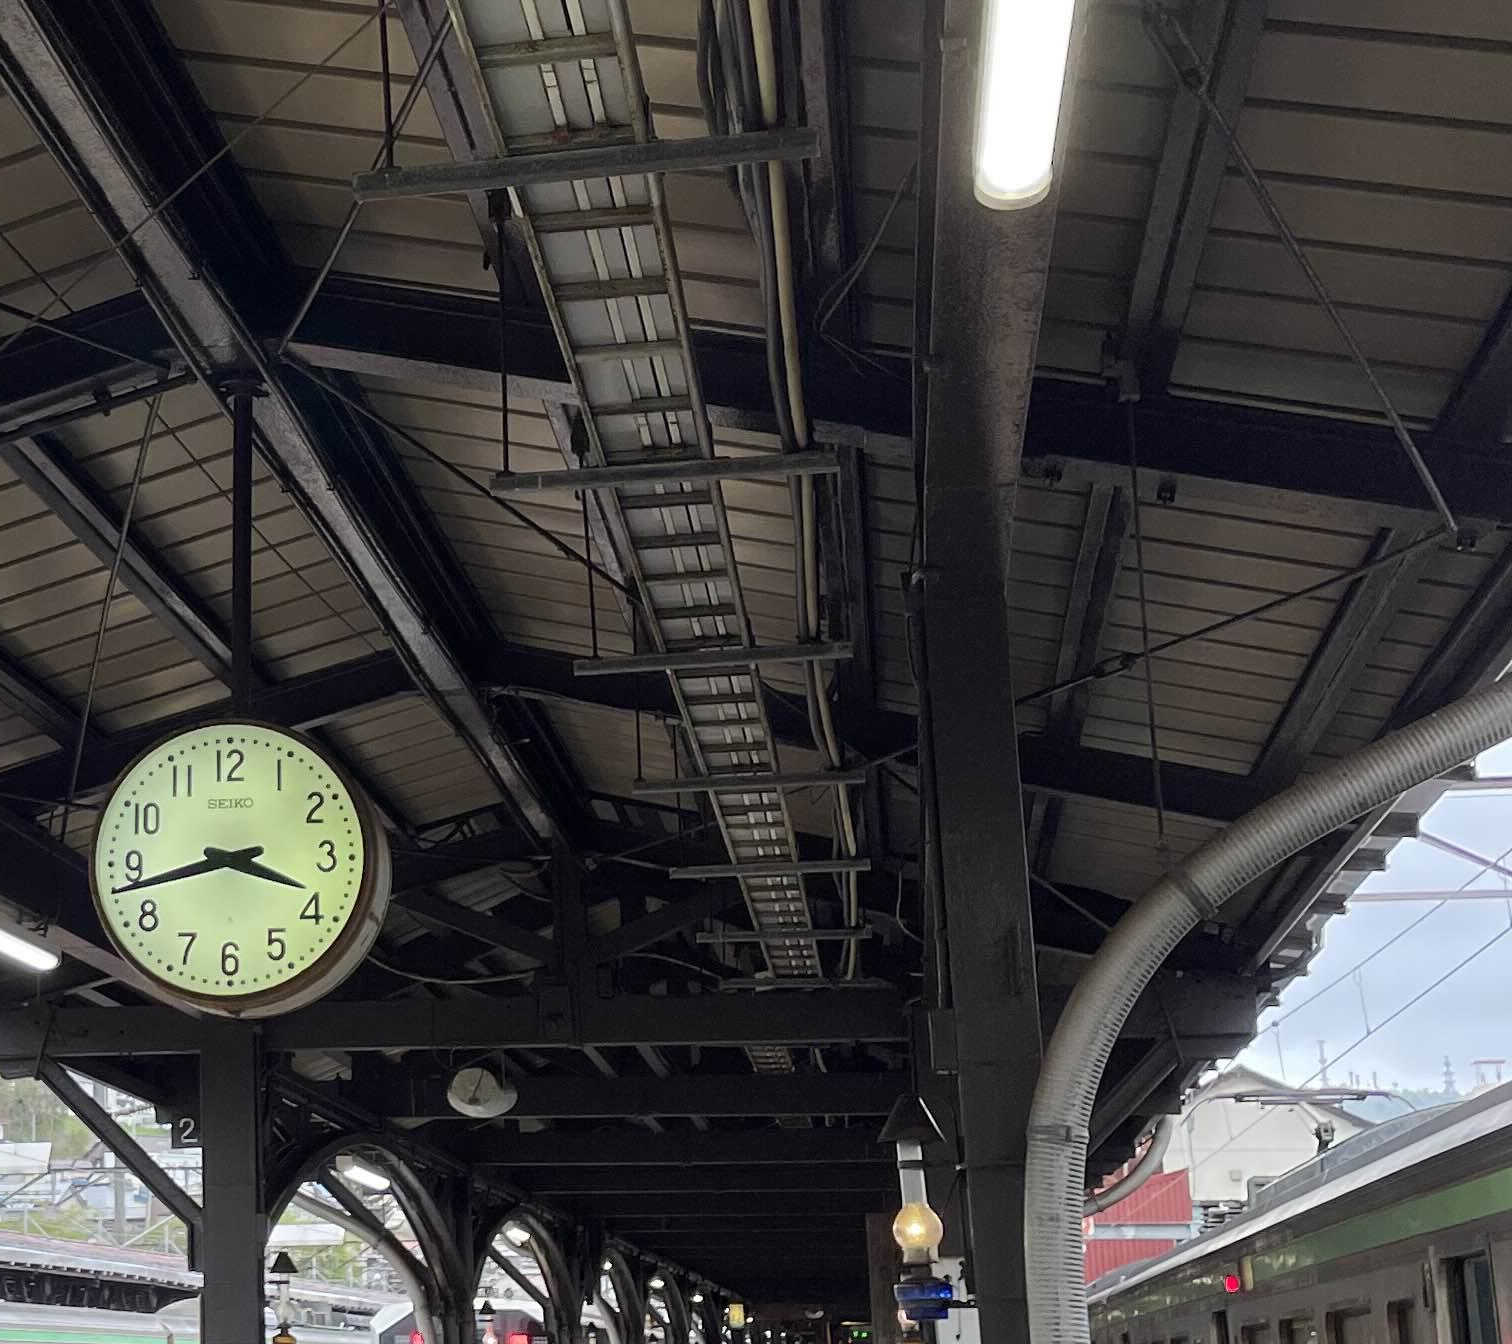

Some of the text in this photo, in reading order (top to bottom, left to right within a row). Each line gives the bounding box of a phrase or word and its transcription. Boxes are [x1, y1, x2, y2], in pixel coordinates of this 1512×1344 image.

[172, 764, 193, 797] 11
[216, 749, 245, 782] 12
[276, 759, 283, 791] 1
[134, 802, 161, 835] 10
[207, 797, 255, 810] SEIKO
[305, 791, 325, 824] 2
[124, 850, 144, 883] 9
[316, 839, 338, 873] 3
[138, 898, 160, 932] 8
[299, 891, 325, 926] 4
[177, 932, 198, 966] 7
[220, 941, 240, 977] 6
[266, 927, 287, 961] 5
[179, 1117, 198, 1143] 2
